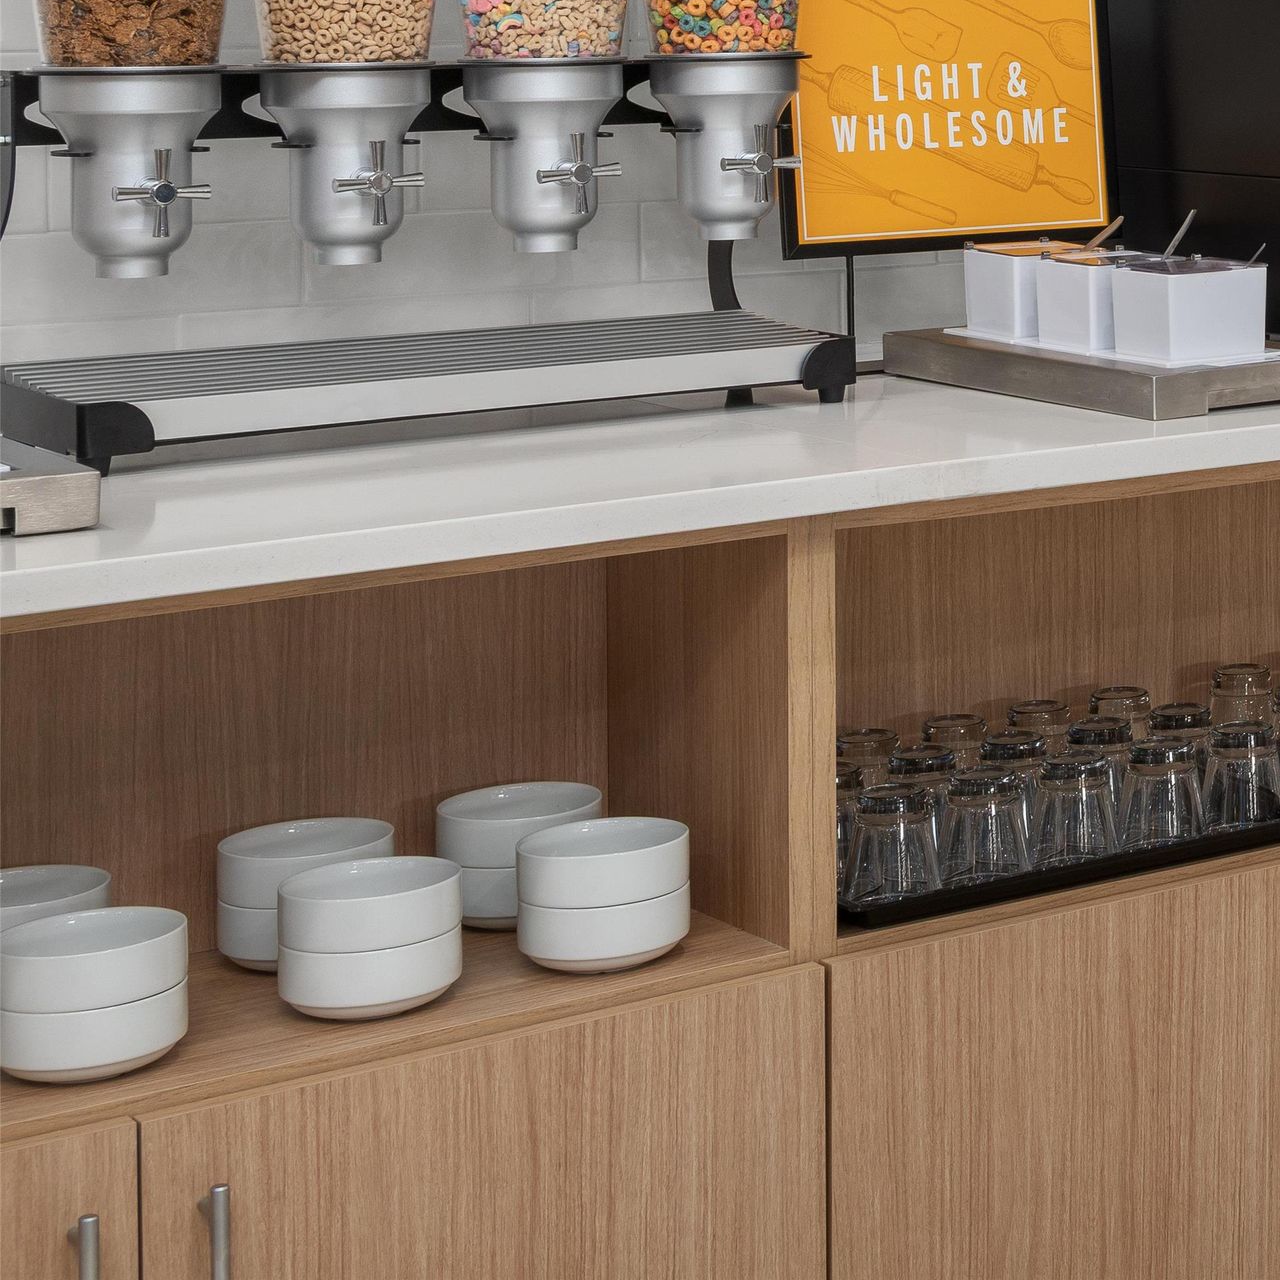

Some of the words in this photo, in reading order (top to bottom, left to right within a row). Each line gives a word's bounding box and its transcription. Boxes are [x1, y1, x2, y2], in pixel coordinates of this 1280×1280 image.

[872, 62, 983, 102] LIGHT
[1007, 61, 1028, 98] &
[831, 107, 1069, 153] WHOLESOME
